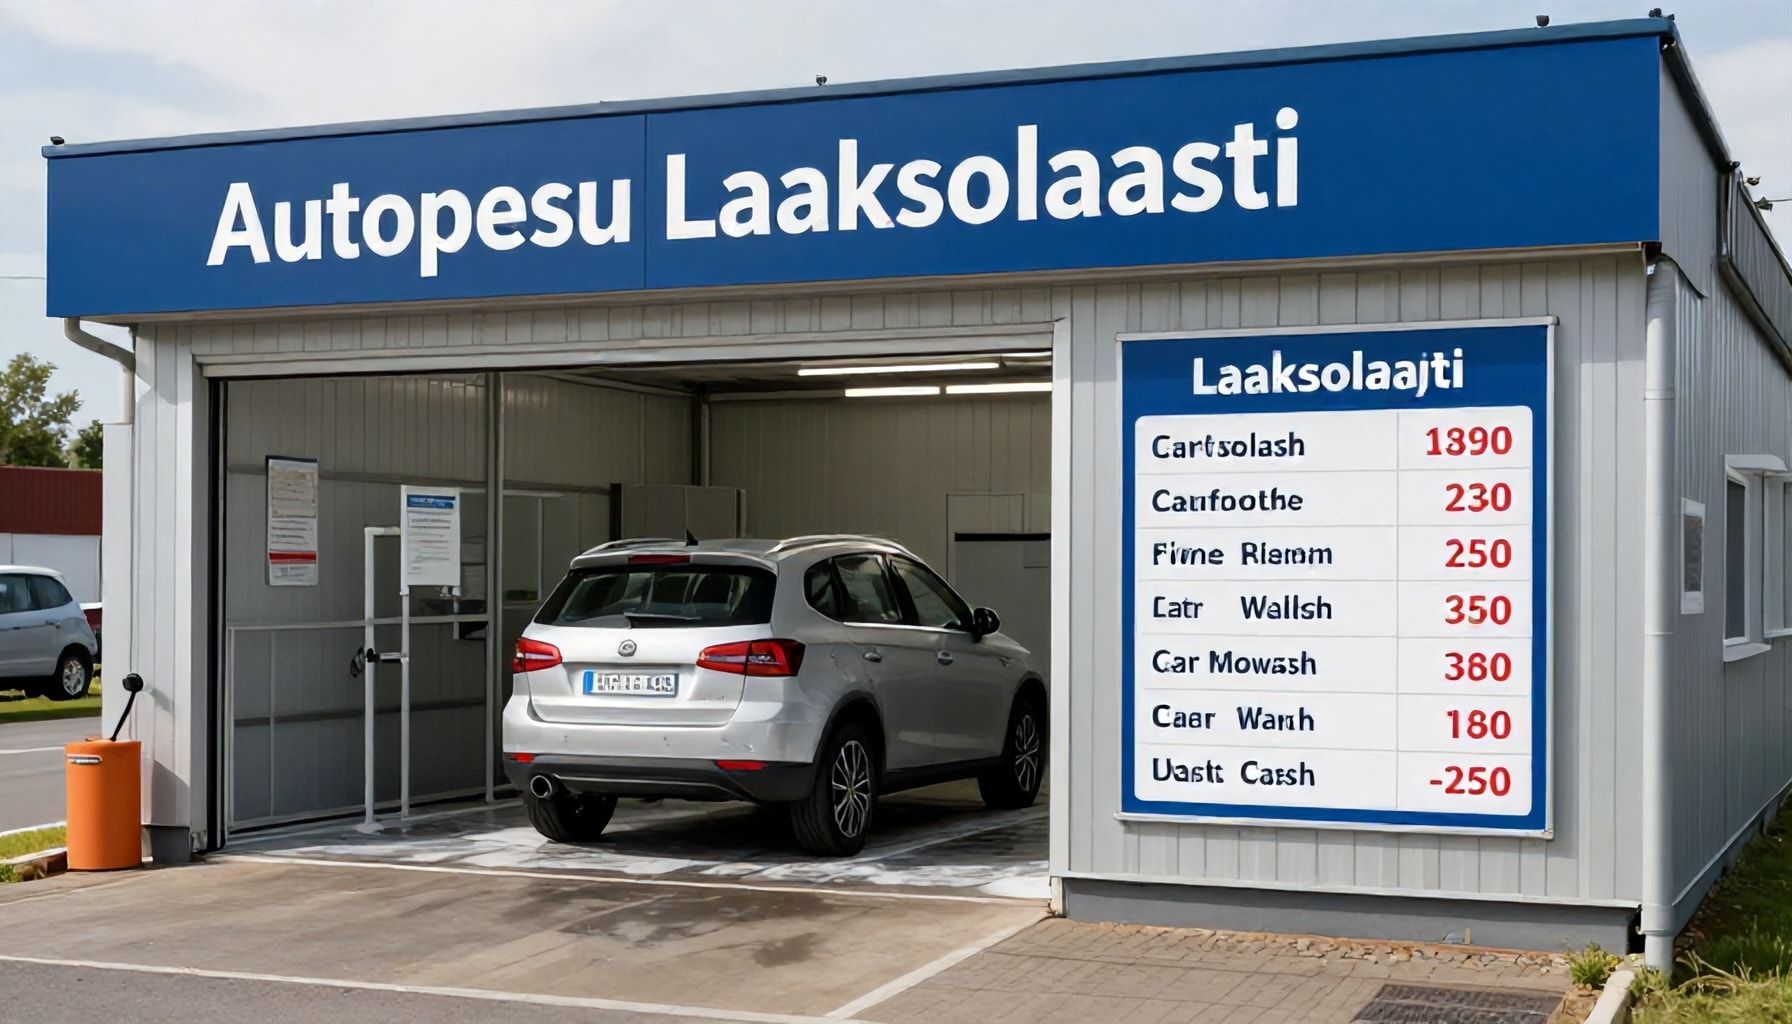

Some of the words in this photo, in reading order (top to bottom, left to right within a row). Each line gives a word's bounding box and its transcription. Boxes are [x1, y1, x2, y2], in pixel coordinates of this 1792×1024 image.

[207, 179, 631, 277] Autopesu
[666, 107, 1300, 240] Laaksolaasti
[1445, 482, 1513, 513] 230
[1445, 538, 1513, 569] 250
[1445, 594, 1513, 626] 350
[1152, 649, 1201, 674] Car
[1446, 709, 1512, 740] 180
[1429, 765, 1512, 797] -250
